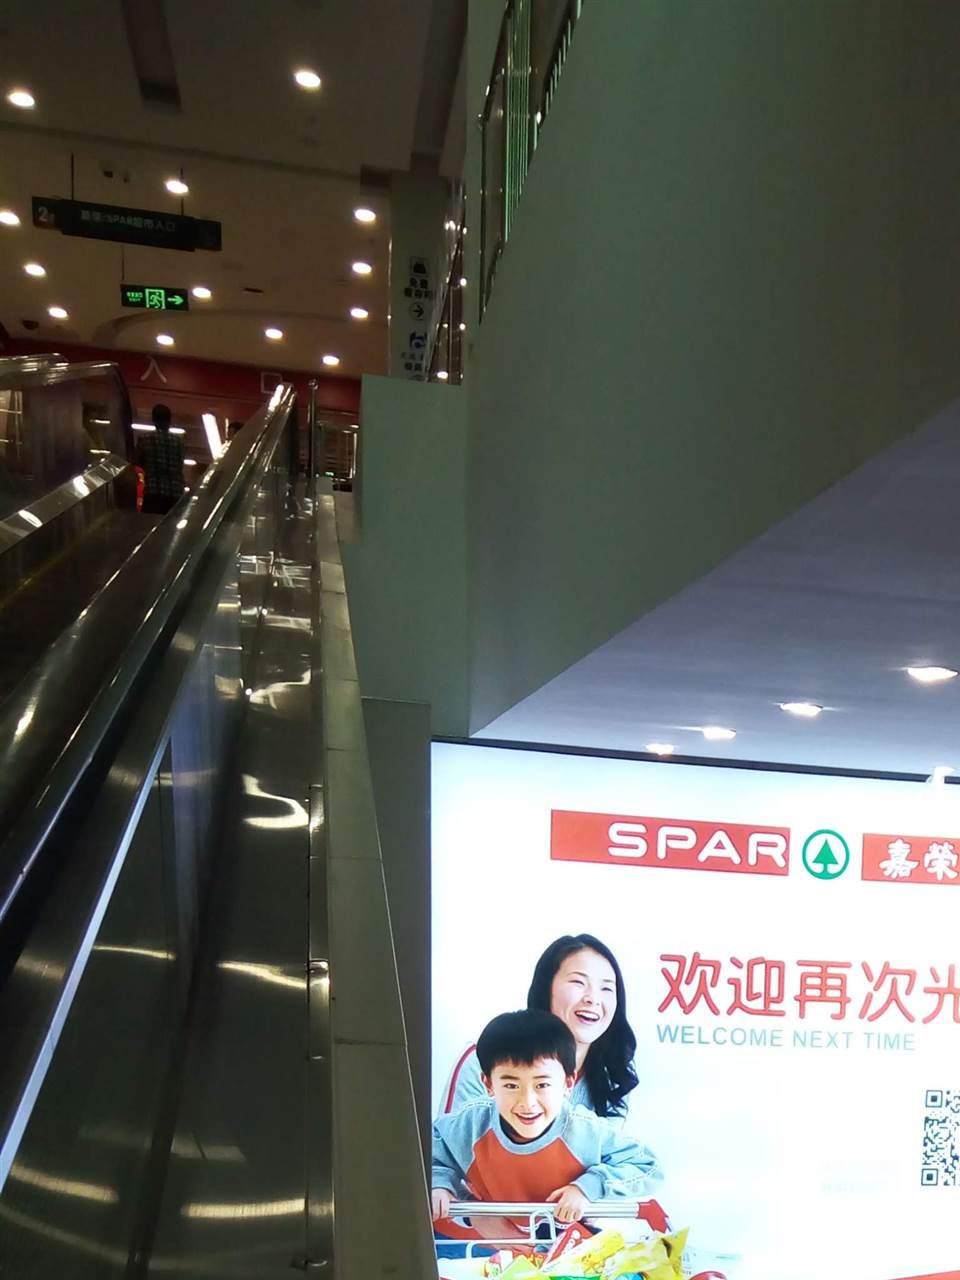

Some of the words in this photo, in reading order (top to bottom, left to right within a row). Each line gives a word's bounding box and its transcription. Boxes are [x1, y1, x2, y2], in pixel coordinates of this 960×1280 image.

[607, 821, 788, 868] SPAR
[879, 838, 960, 881] 嘉榮
[656, 1023, 784, 1047] WELCOME
[793, 1030, 853, 1049] NEXT
[863, 1031, 915, 1051] TIME
